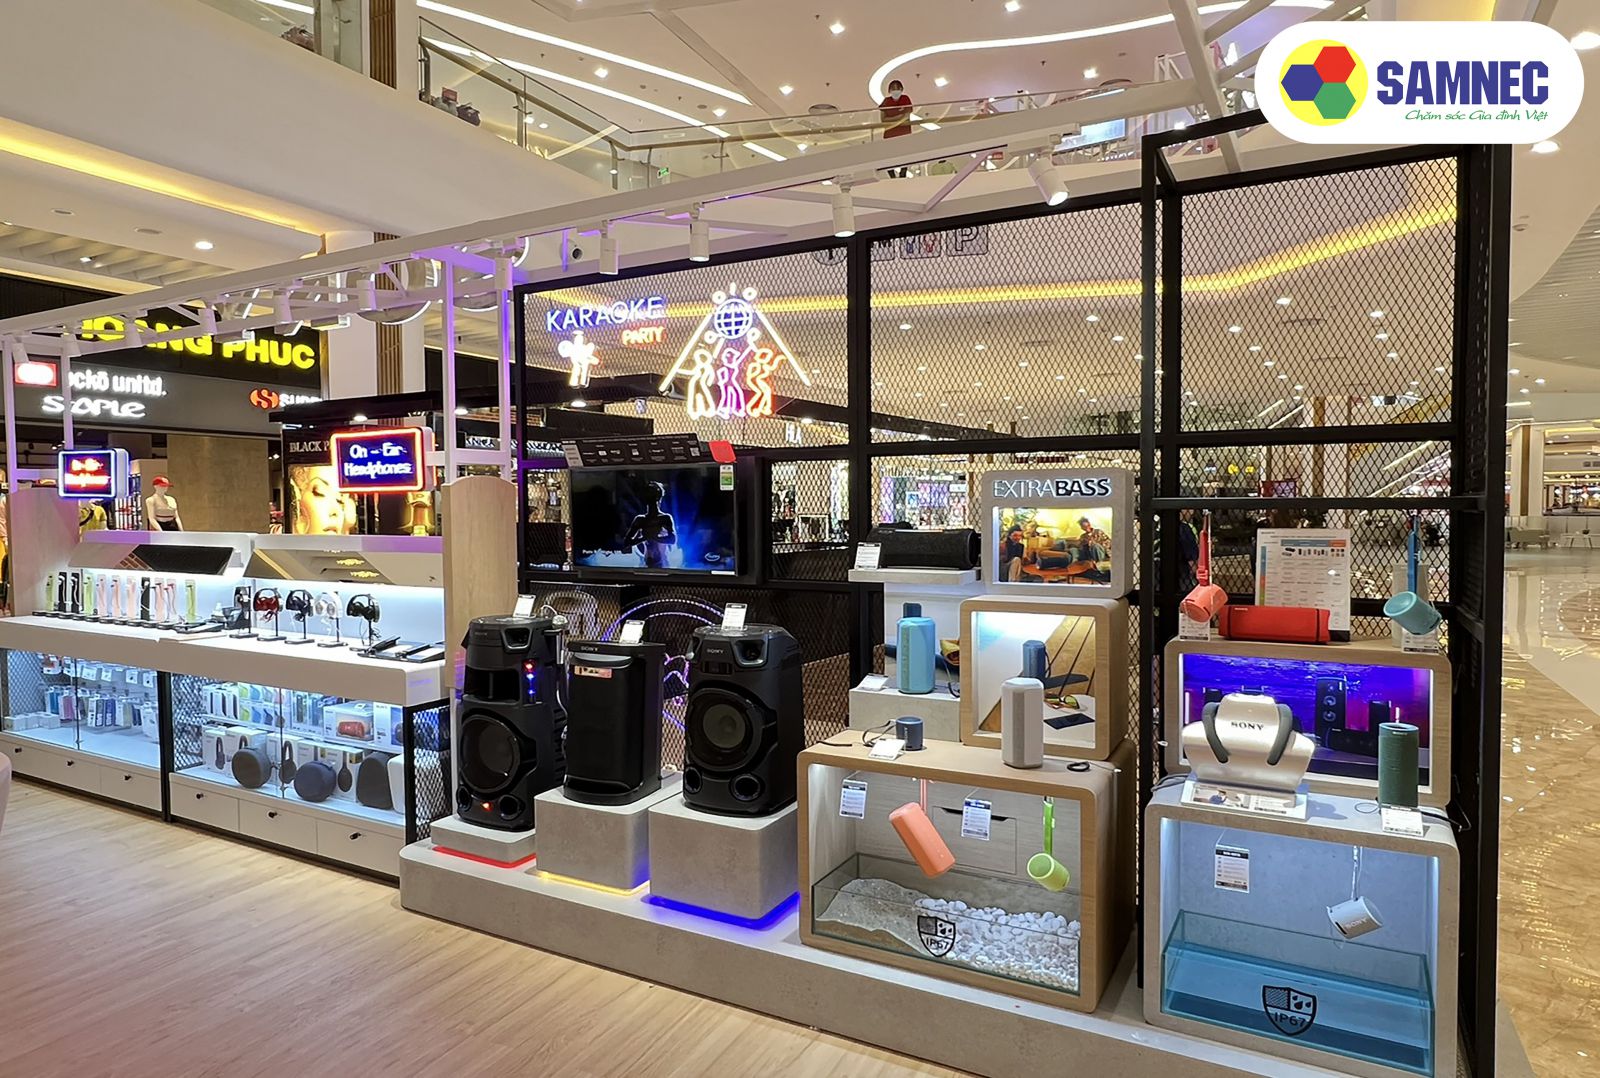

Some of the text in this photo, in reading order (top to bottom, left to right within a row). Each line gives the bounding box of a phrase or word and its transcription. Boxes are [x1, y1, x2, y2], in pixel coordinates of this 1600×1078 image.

[545, 296, 666, 333] KARAOKE
[622, 327, 664, 346] PARTY
[222, 337, 315, 370] PHUC
[289, 441, 321, 453] BLACK
[350, 444, 368, 459] On
[382, 442, 407, 457] Ear
[344, 461, 413, 479] Headphones
[992, 478, 1112, 498] EXTRABASS
[1231, 721, 1265, 731] SONY
[926, 938, 950, 950] IP67
[1275, 1012, 1306, 1027] IP67
